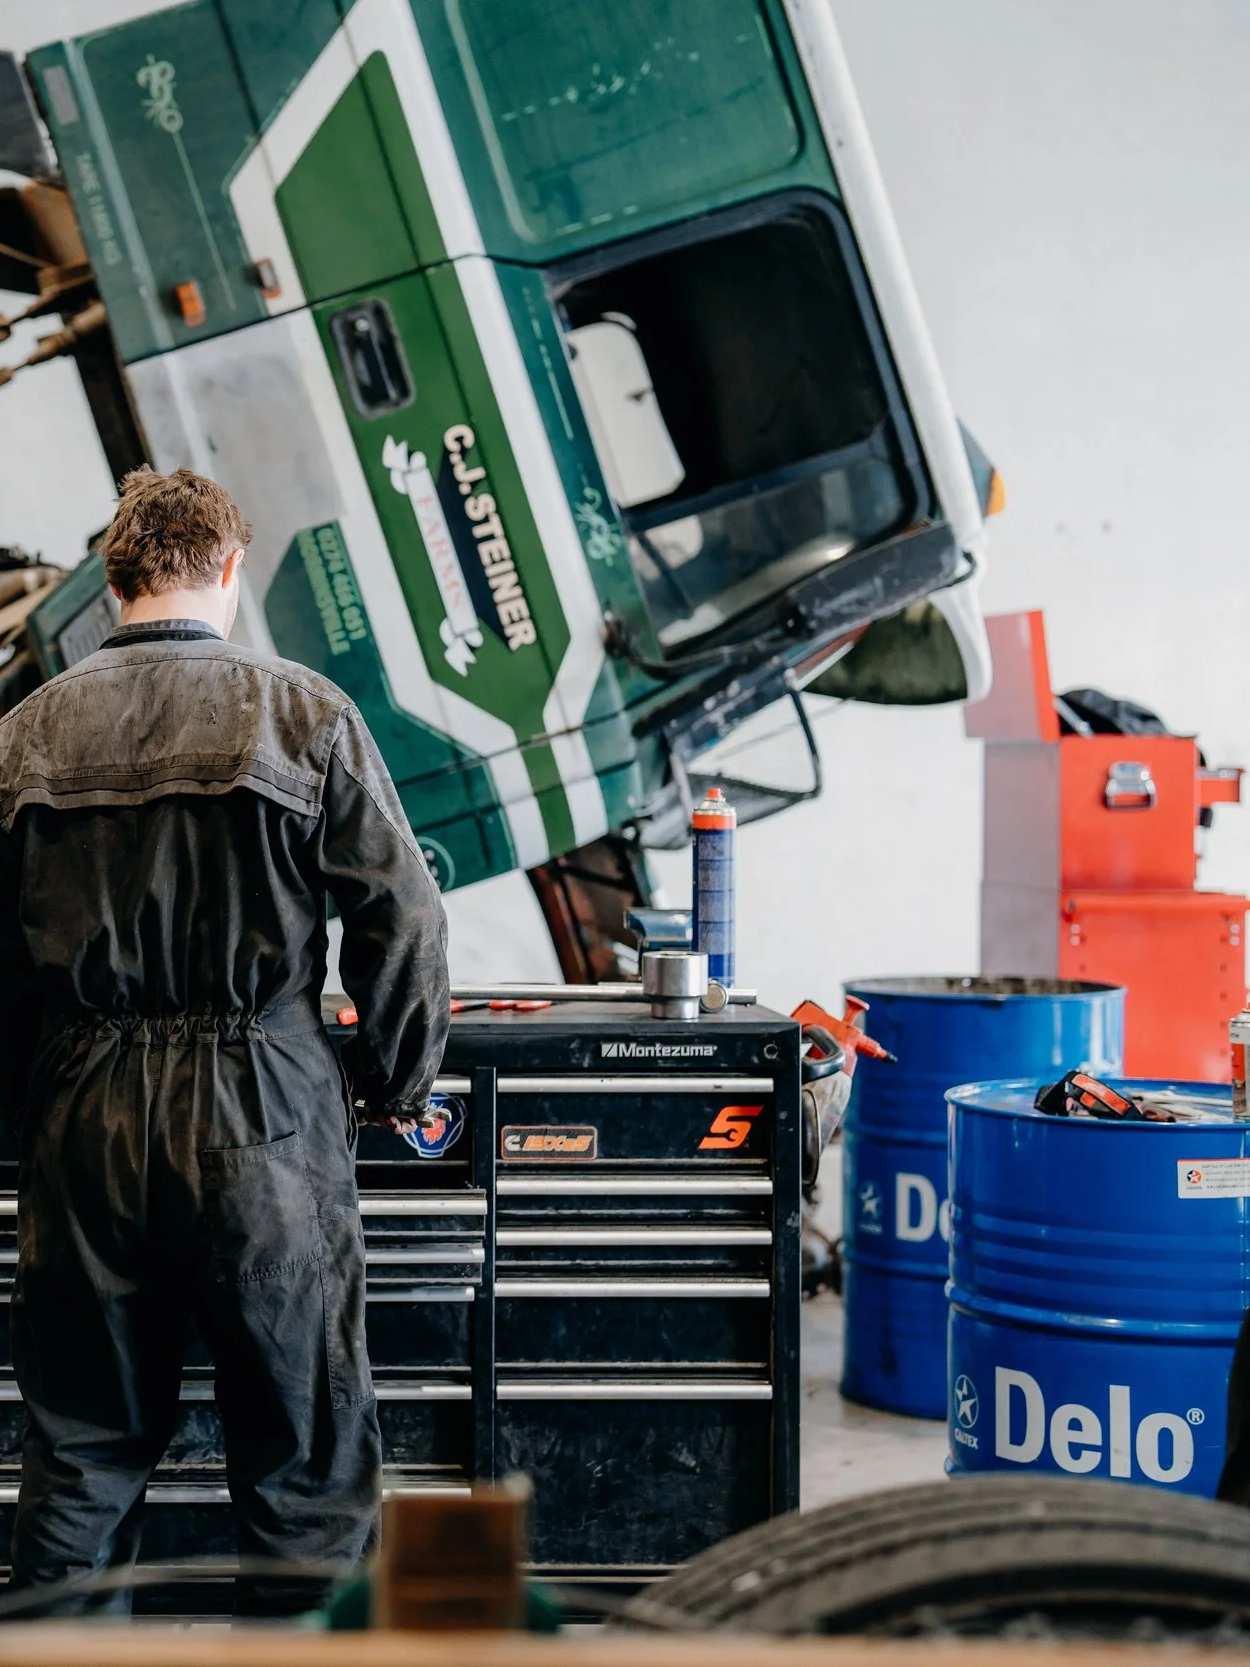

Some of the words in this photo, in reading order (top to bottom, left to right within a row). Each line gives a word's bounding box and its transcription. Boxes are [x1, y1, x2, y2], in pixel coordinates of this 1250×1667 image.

[444, 424, 485, 495] C.J.
[416, 495, 464, 609] FARMS
[464, 493, 536, 652] STEINER
[619, 1043, 713, 1057] Montezuma
